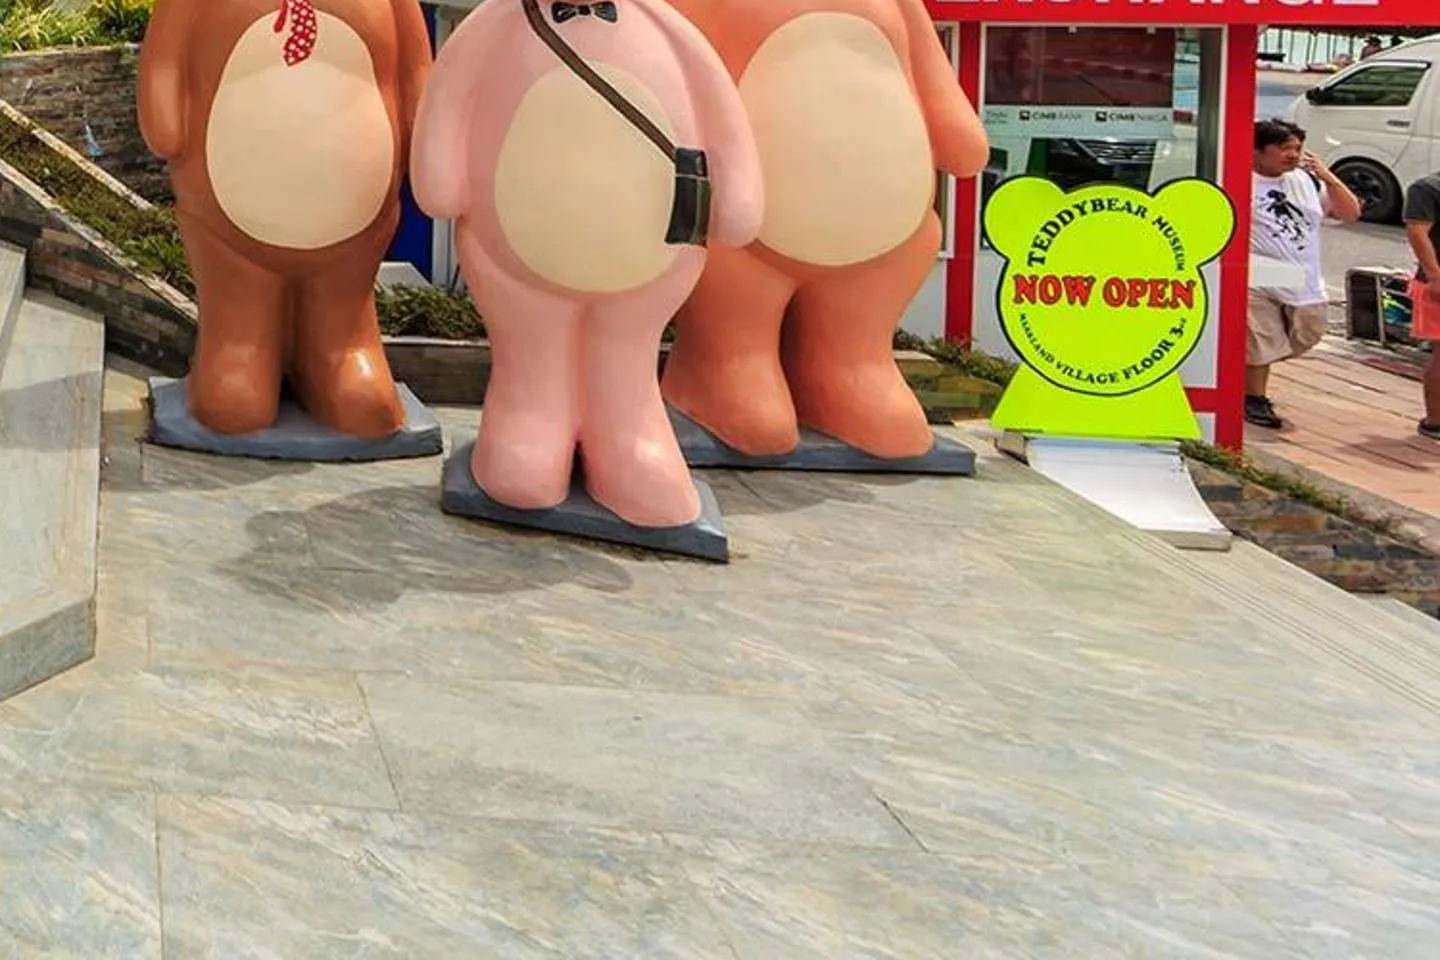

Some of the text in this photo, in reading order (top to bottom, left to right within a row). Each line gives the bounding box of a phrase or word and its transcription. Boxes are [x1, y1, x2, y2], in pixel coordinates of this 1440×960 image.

[1027, 197, 1186, 271] TEDDYBEAR MUSEUM
[1013, 274, 1197, 309] NOW OPEN
[1056, 361, 1121, 384] VILLAGE
[1122, 339, 1176, 380] FLOOR
